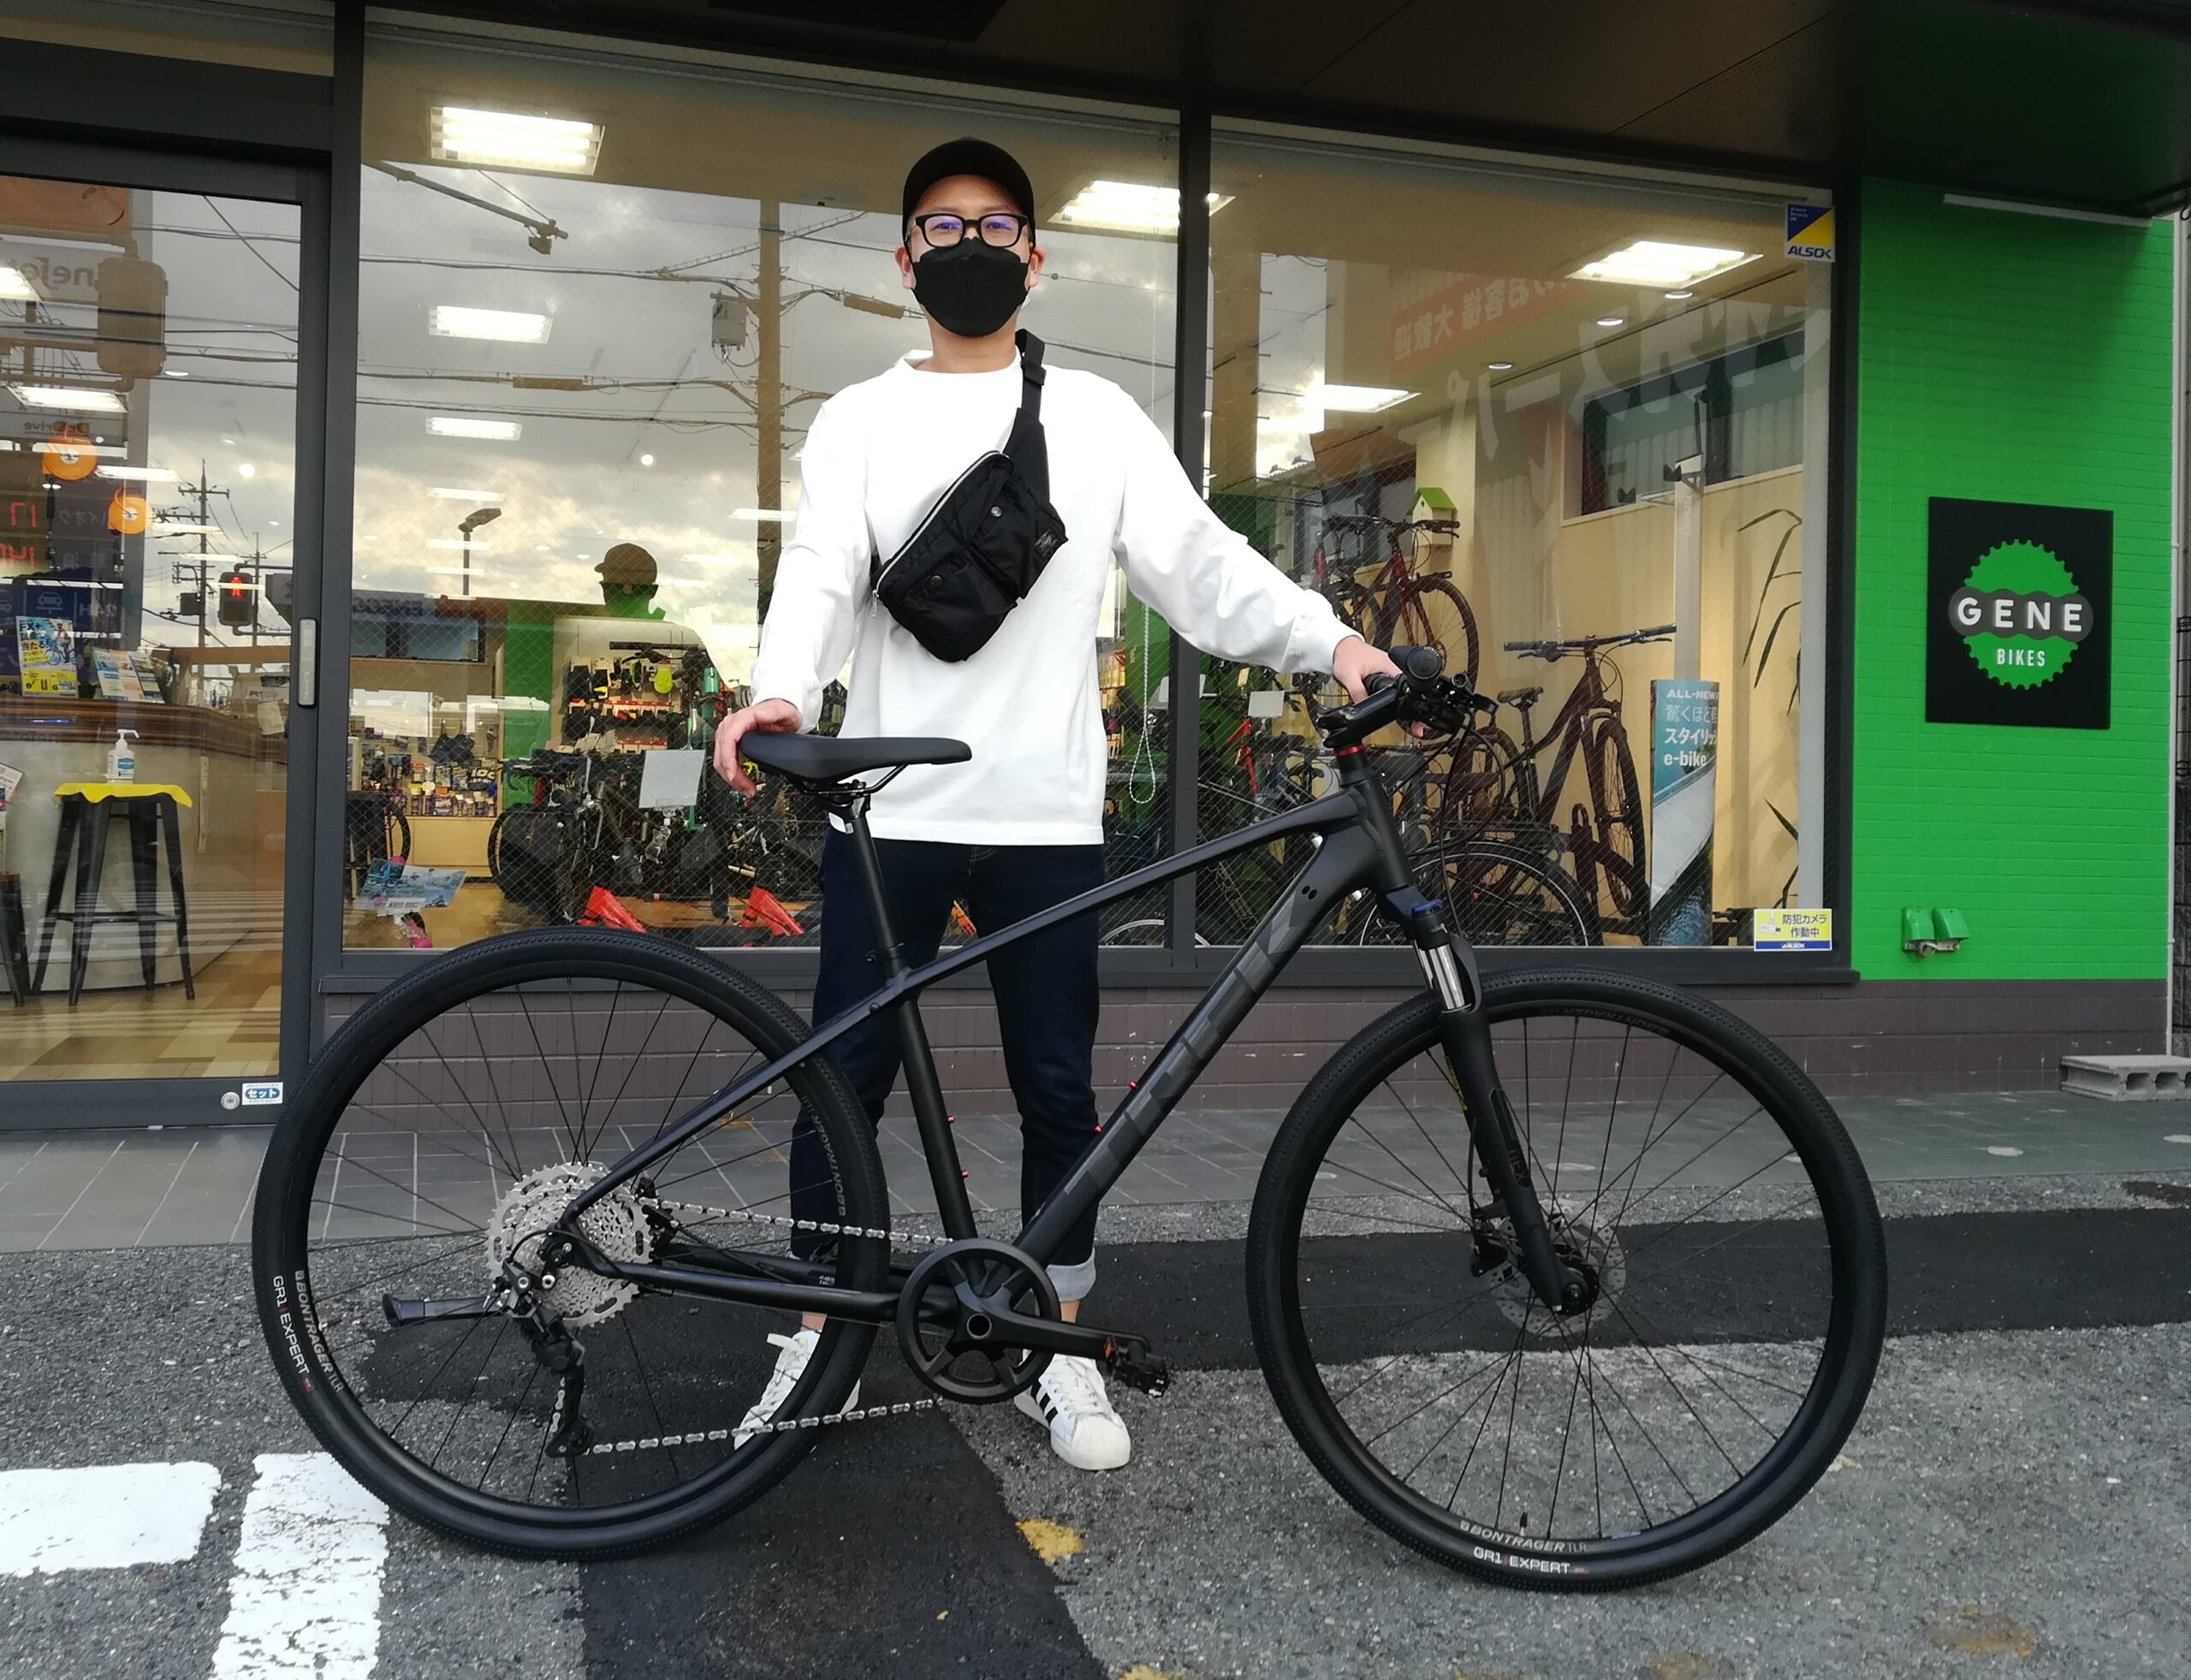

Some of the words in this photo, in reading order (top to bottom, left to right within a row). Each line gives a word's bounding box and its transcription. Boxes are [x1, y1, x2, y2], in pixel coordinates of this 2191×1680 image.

[1787, 246, 1832, 259] ALSOK
[1958, 597, 2081, 632] GENE
[1997, 649, 2046, 667] BIKES
[1664, 751, 1707, 767] e-bike
[1783, 914, 1827, 924] 防犯カメラ
[1790, 927, 1820, 938] 作動中
[246, 1088, 277, 1098] セット
[273, 1275, 288, 1308] GR1
[280, 1312, 310, 1374] EXPERT
[296, 1284, 334, 1373] BONTRAGER
[328, 1373, 344, 1393] TLR
[1470, 1526, 1565, 1552] BONTRAGER
[1473, 1546, 1503, 1565] GR1
[1509, 1555, 1571, 1575] EXPERT
